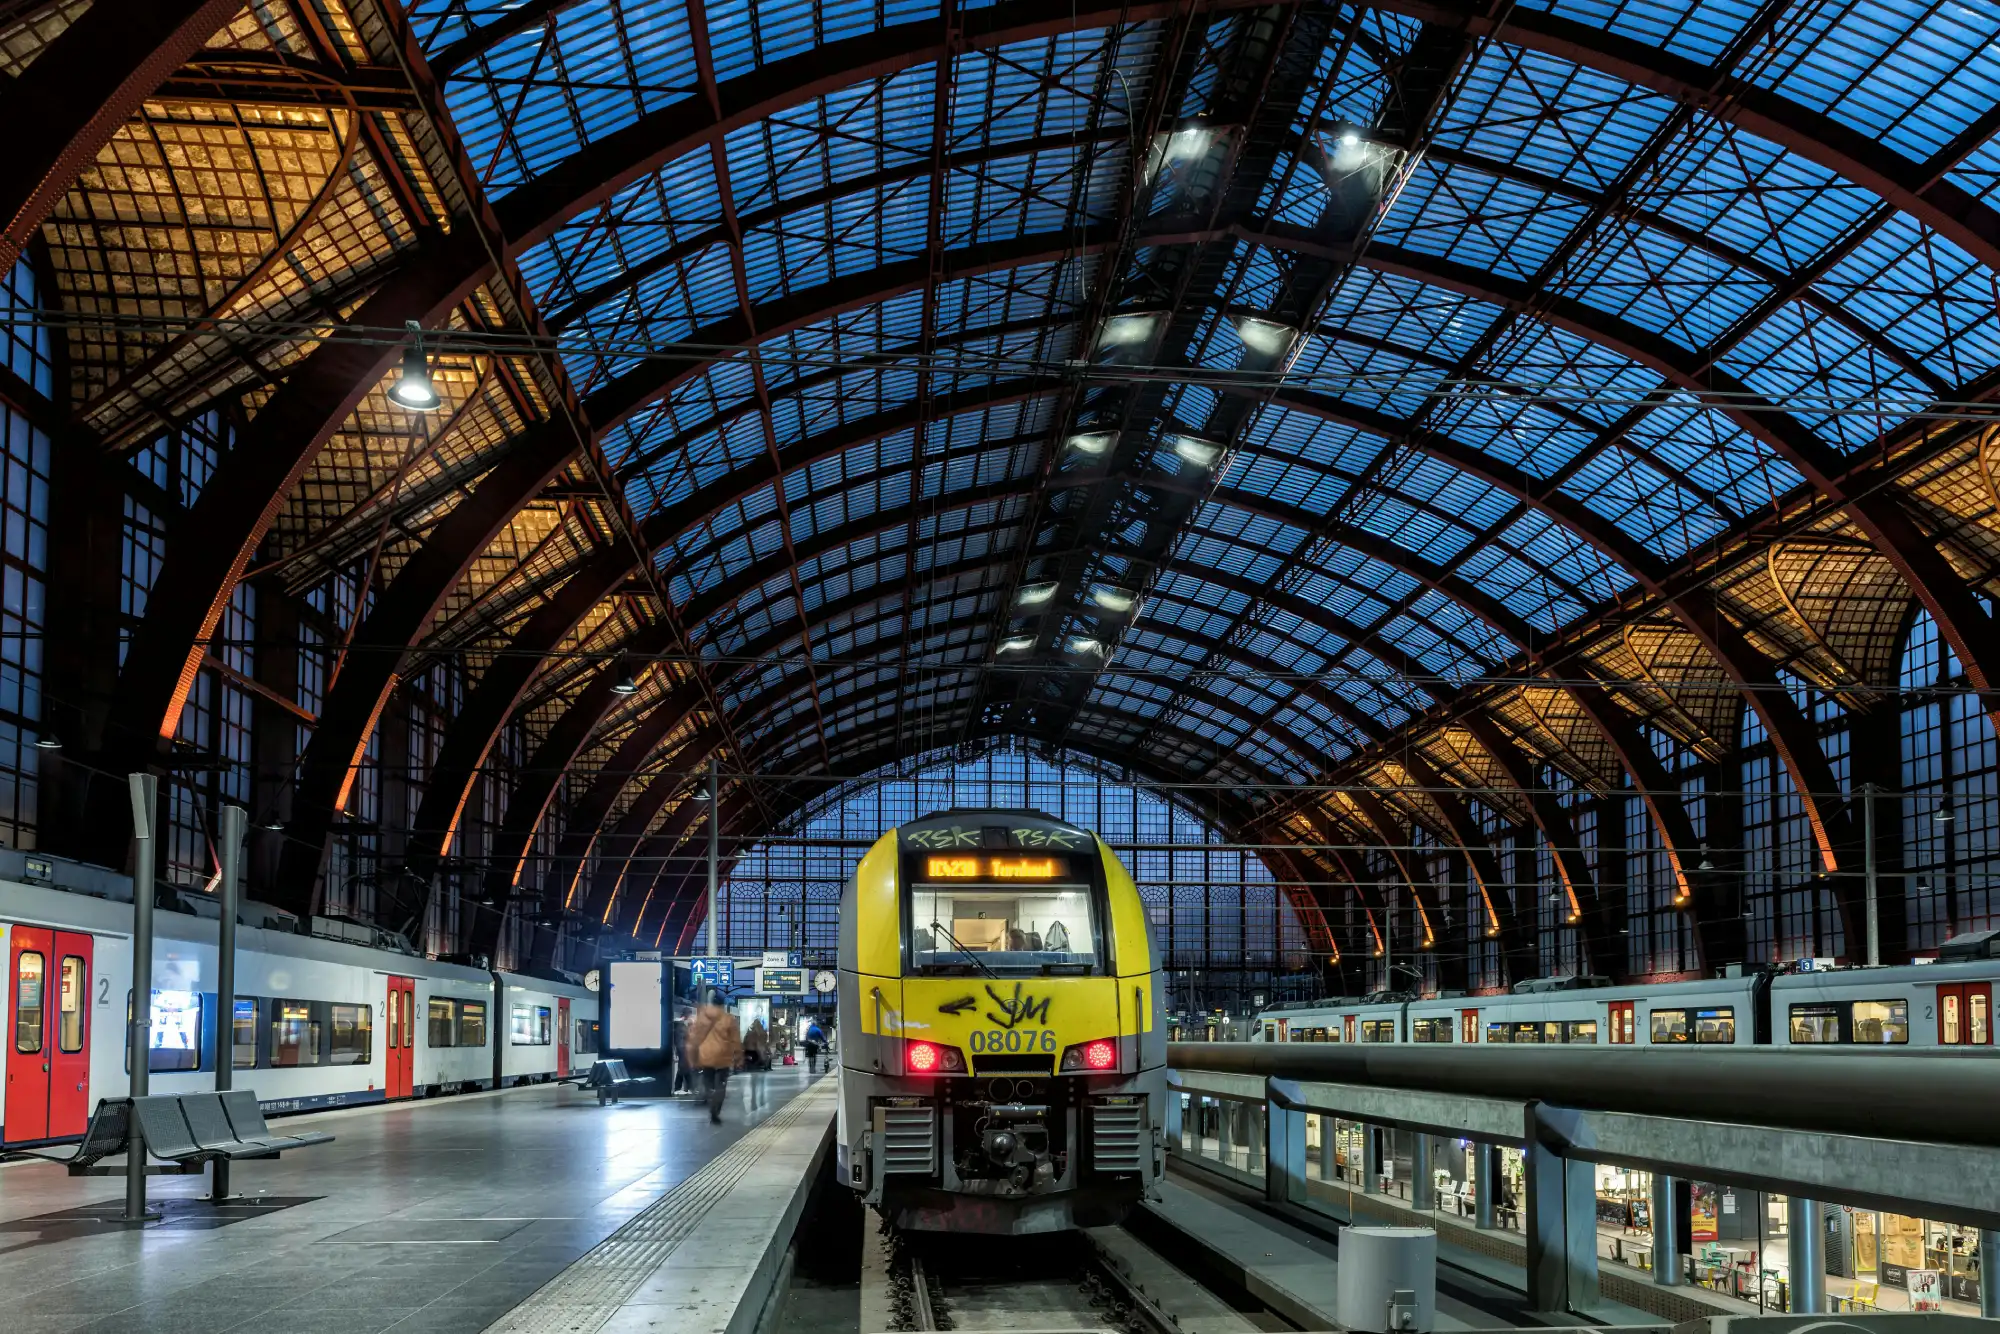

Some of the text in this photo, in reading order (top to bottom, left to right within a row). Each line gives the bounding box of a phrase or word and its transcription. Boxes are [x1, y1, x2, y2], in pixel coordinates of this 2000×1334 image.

[99, 978, 109, 1005] 2
[380, 1000, 385, 1018] 2
[416, 1003, 421, 1020] 2
[1925, 1005, 1934, 1020] 2
[969, 1030, 1057, 1053] 08076
